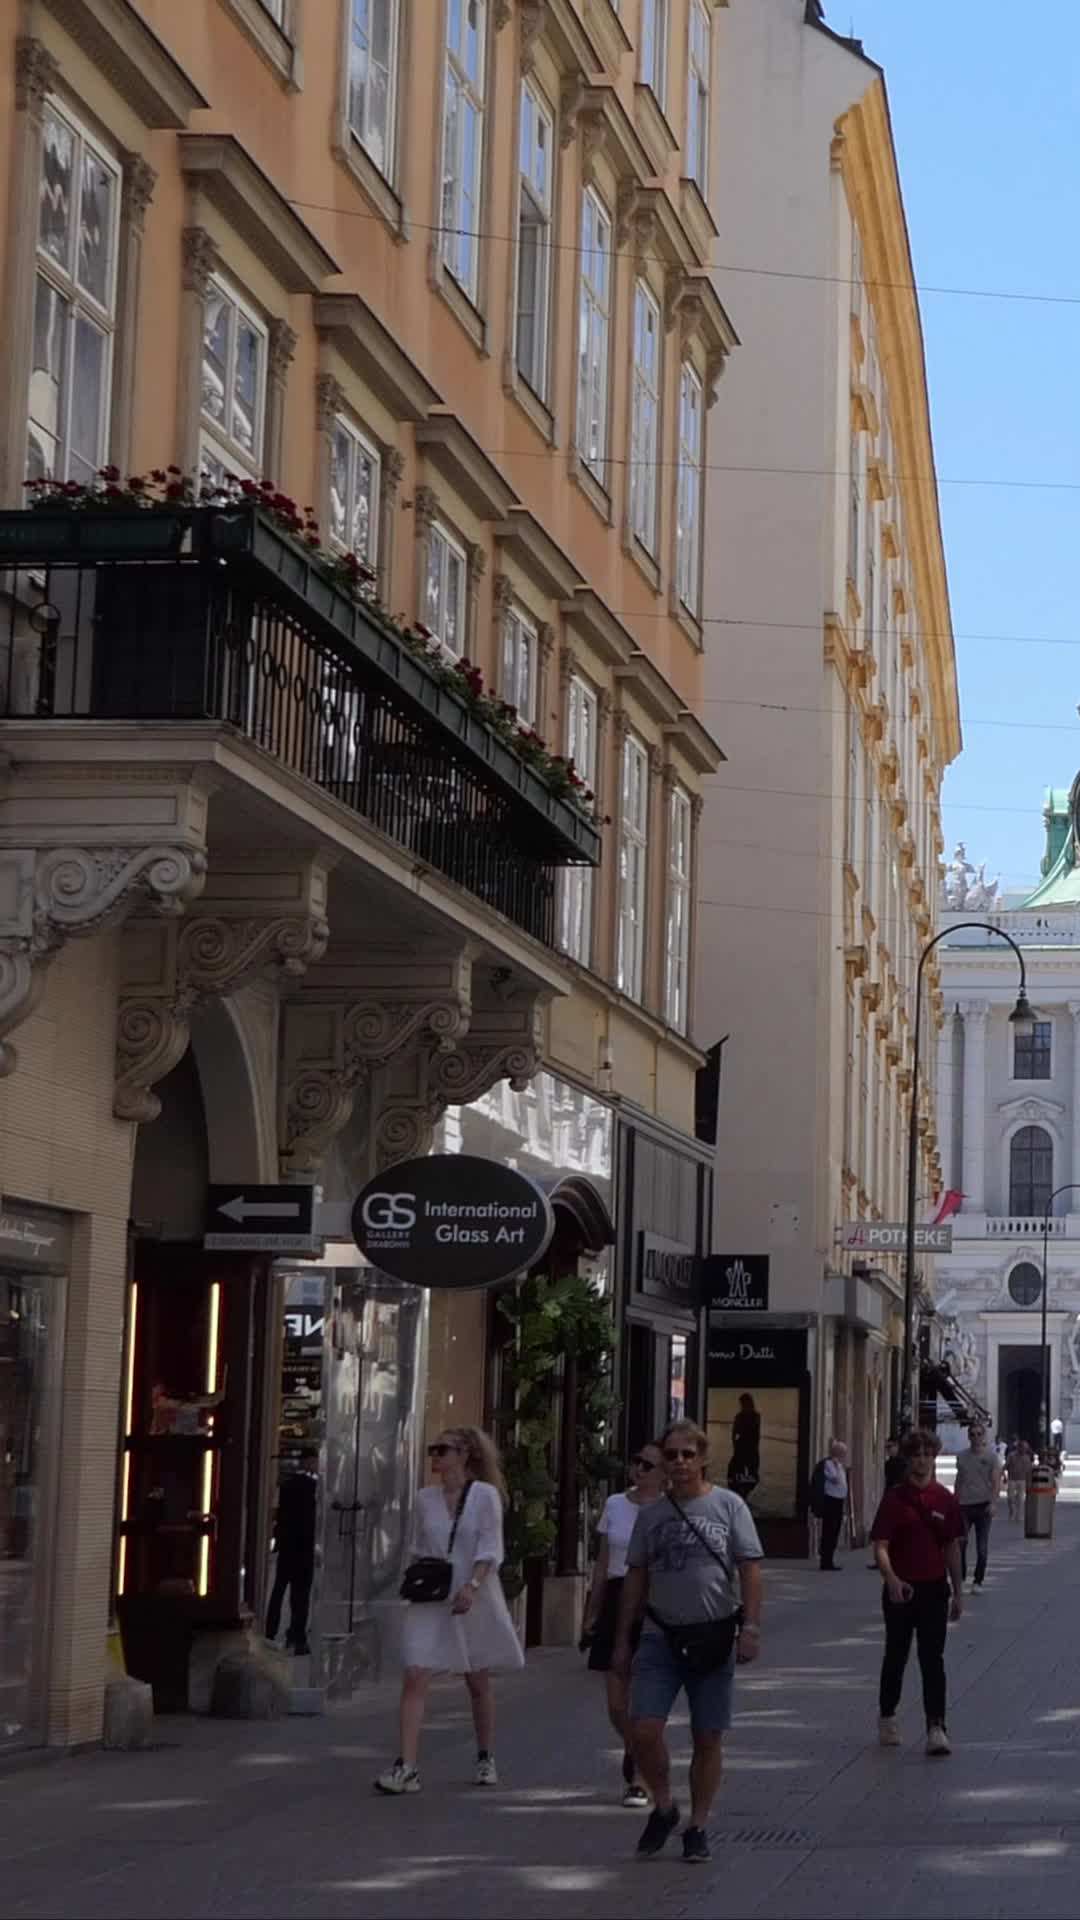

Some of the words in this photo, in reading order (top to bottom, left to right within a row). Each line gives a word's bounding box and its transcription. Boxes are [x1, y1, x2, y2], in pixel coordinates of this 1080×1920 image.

[362, 1192, 416, 1230] GS
[424, 1200, 537, 1219] International
[367, 1231, 411, 1239] GALLERY
[435, 1225, 489, 1244] Glass
[495, 1226, 525, 1244] Art
[711, 1296, 764, 1308] MONCLER
